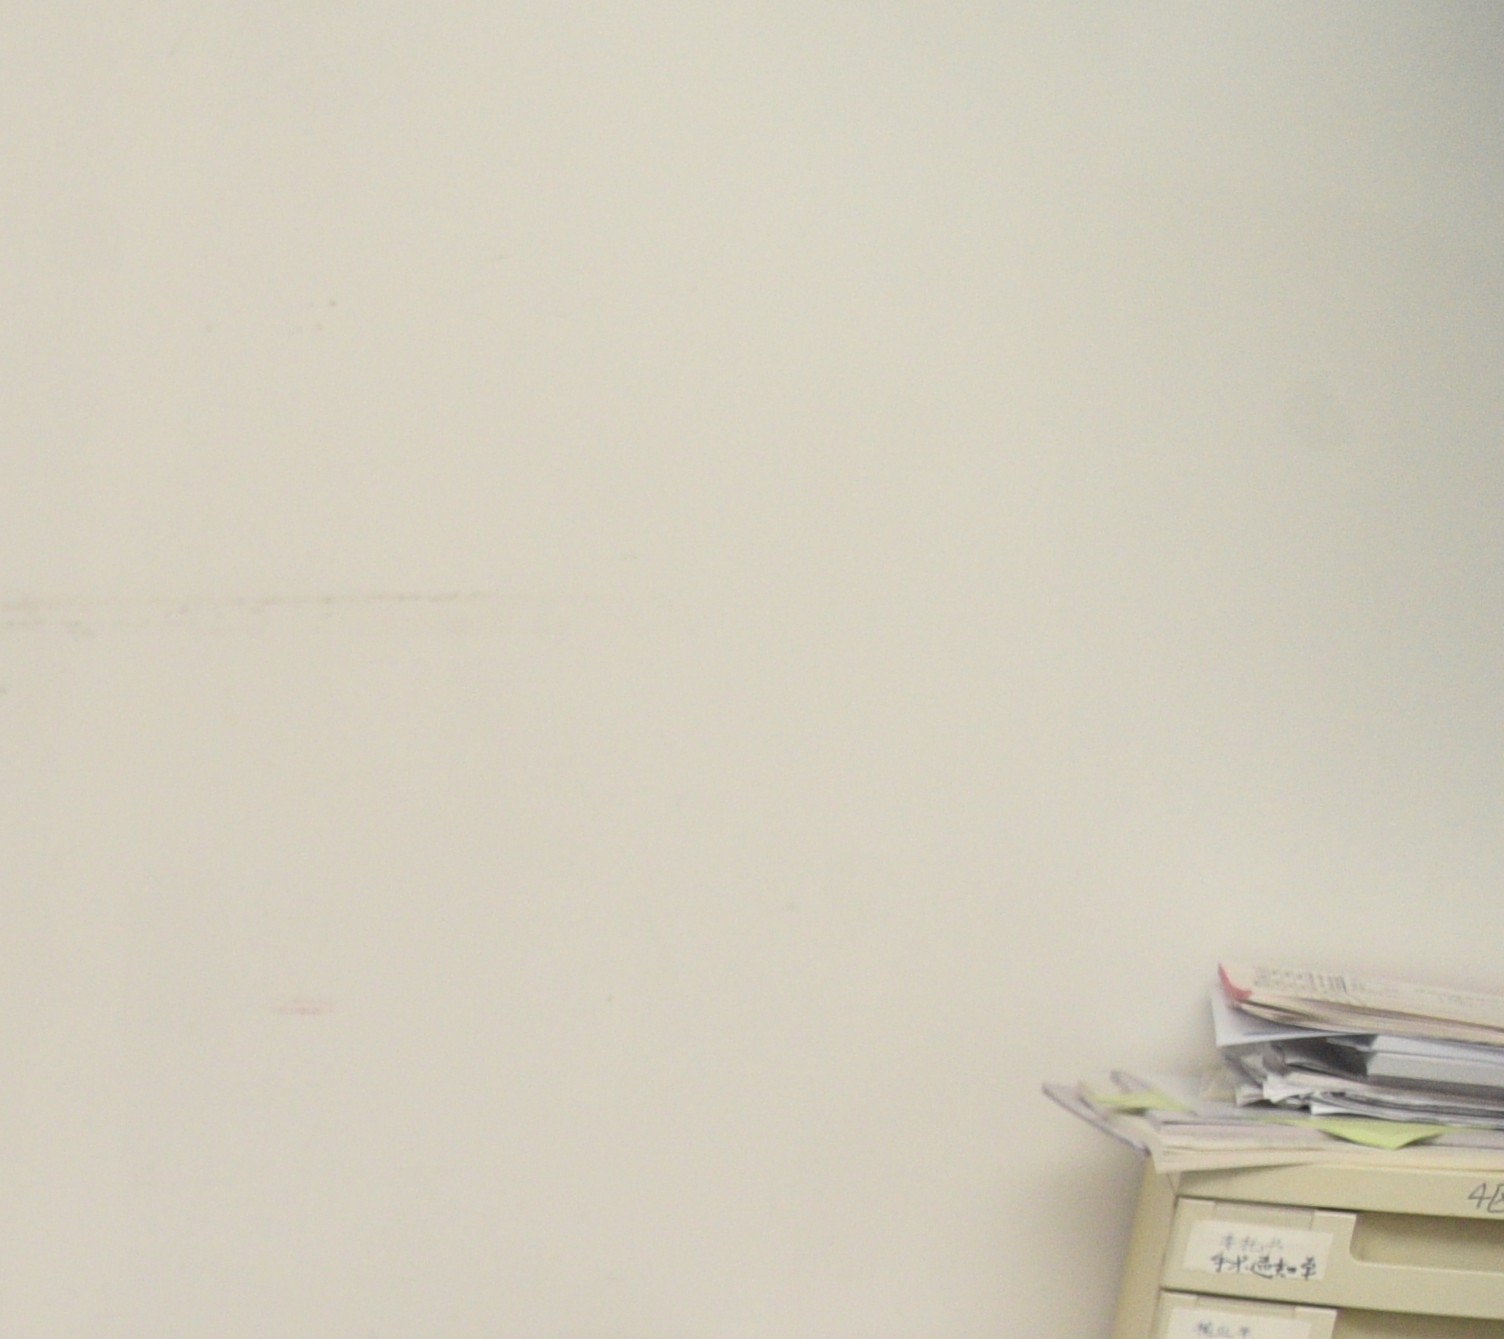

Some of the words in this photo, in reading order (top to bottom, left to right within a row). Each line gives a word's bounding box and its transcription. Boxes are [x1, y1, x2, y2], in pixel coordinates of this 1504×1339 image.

[1210, 1254, 1318, 1281] 手术通知单
